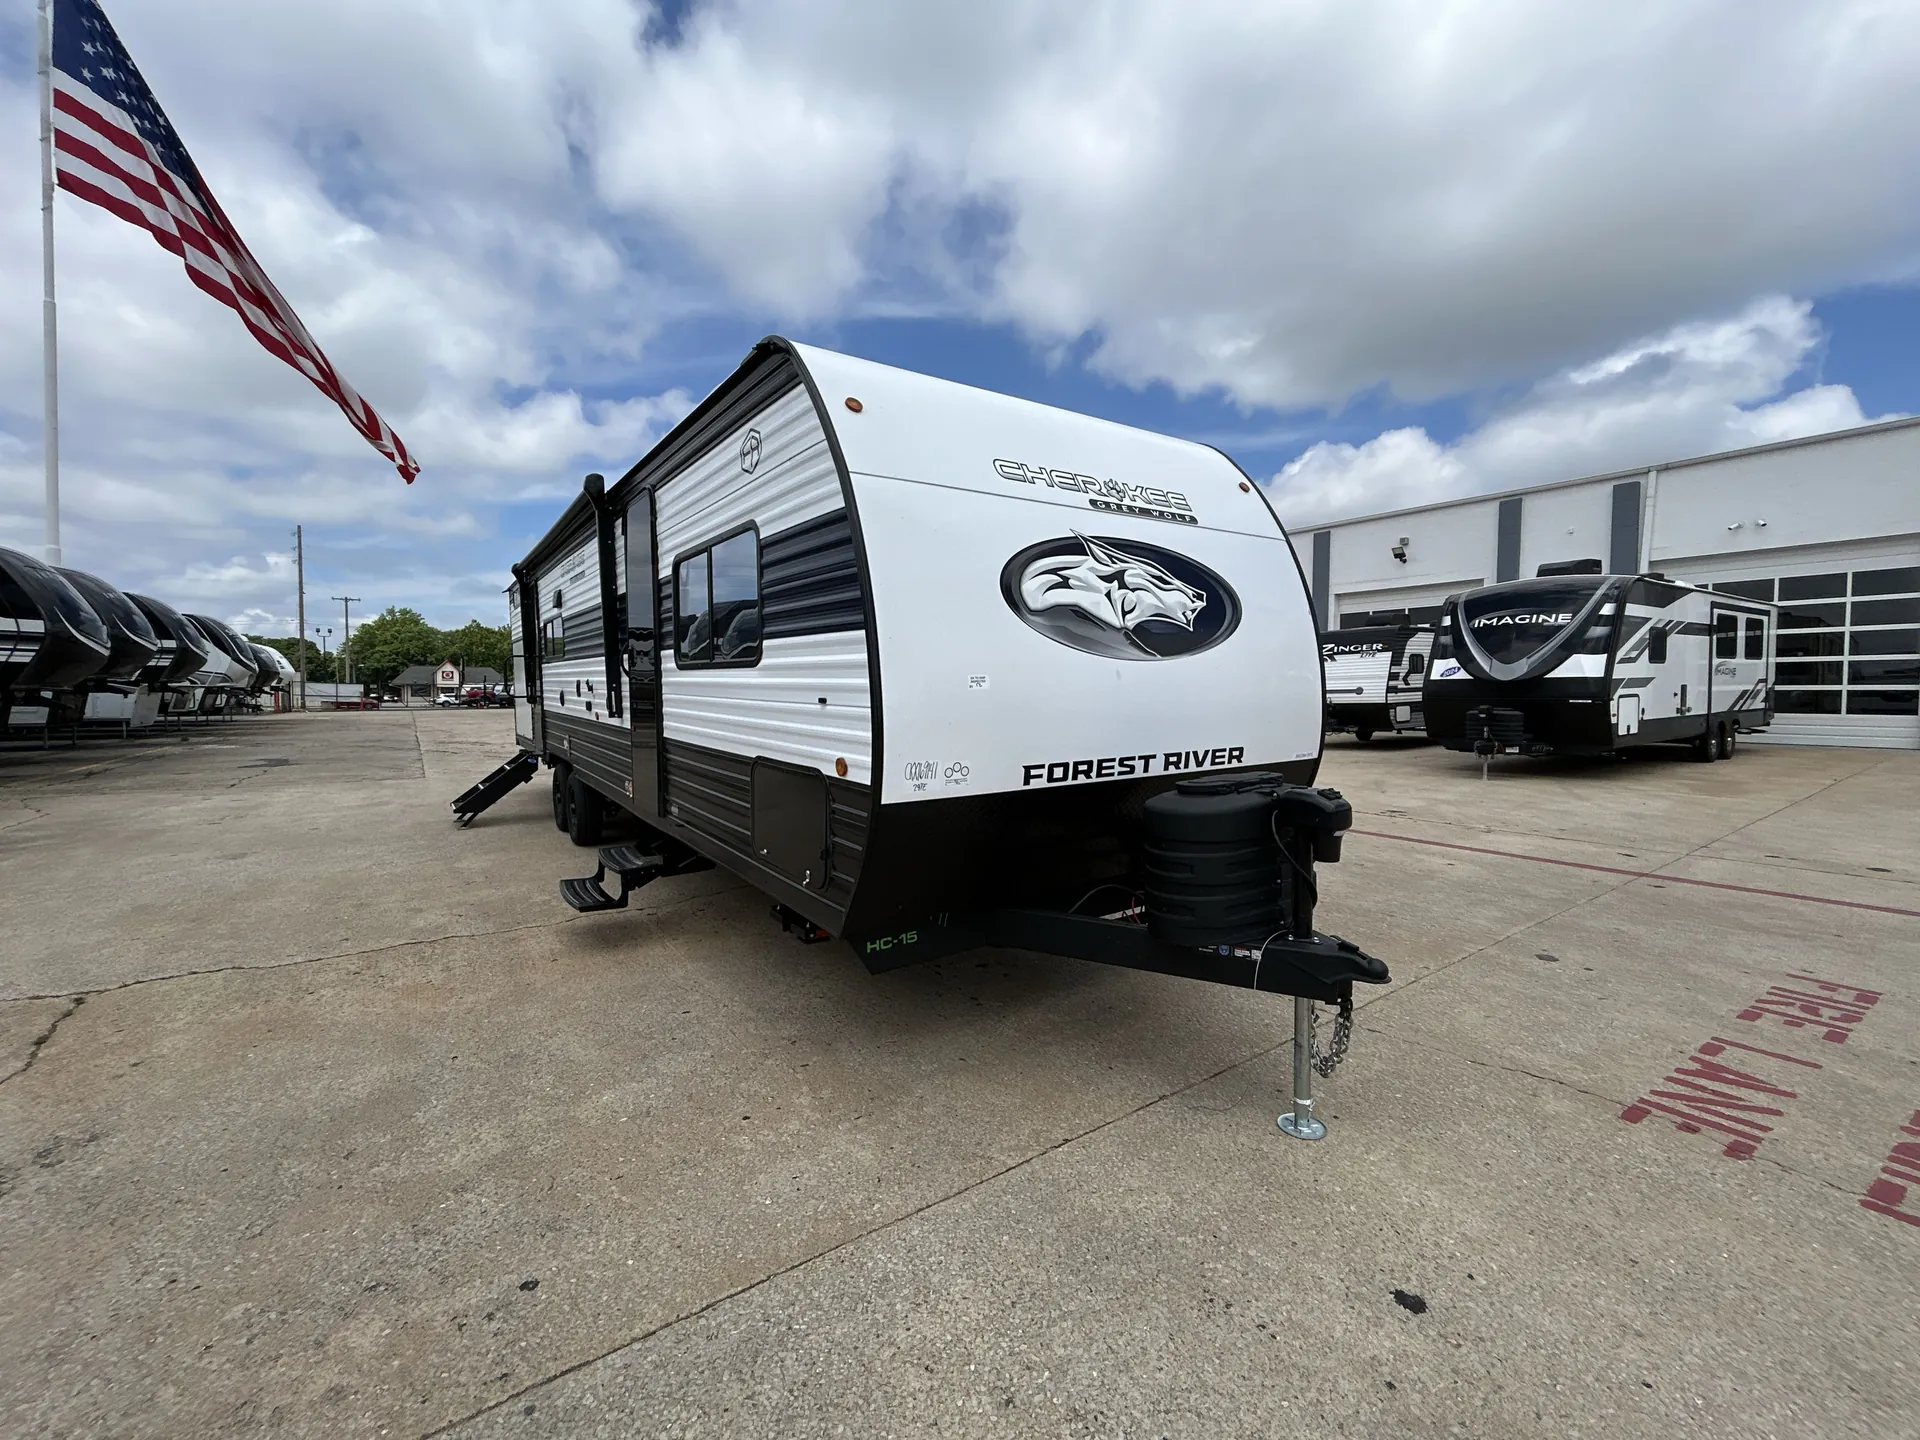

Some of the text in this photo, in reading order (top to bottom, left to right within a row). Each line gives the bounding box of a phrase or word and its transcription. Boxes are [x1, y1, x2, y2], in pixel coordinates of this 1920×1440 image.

[1096, 501, 1193, 522] GREY WOLF
[1474, 613, 1573, 628] IMAGINE
[1322, 643, 1384, 655] ZINGER
[1022, 746, 1245, 786] FOREST RIVER
[866, 930, 918, 953] HC-15
[1620, 973, 1884, 1161] FIRE LANE
